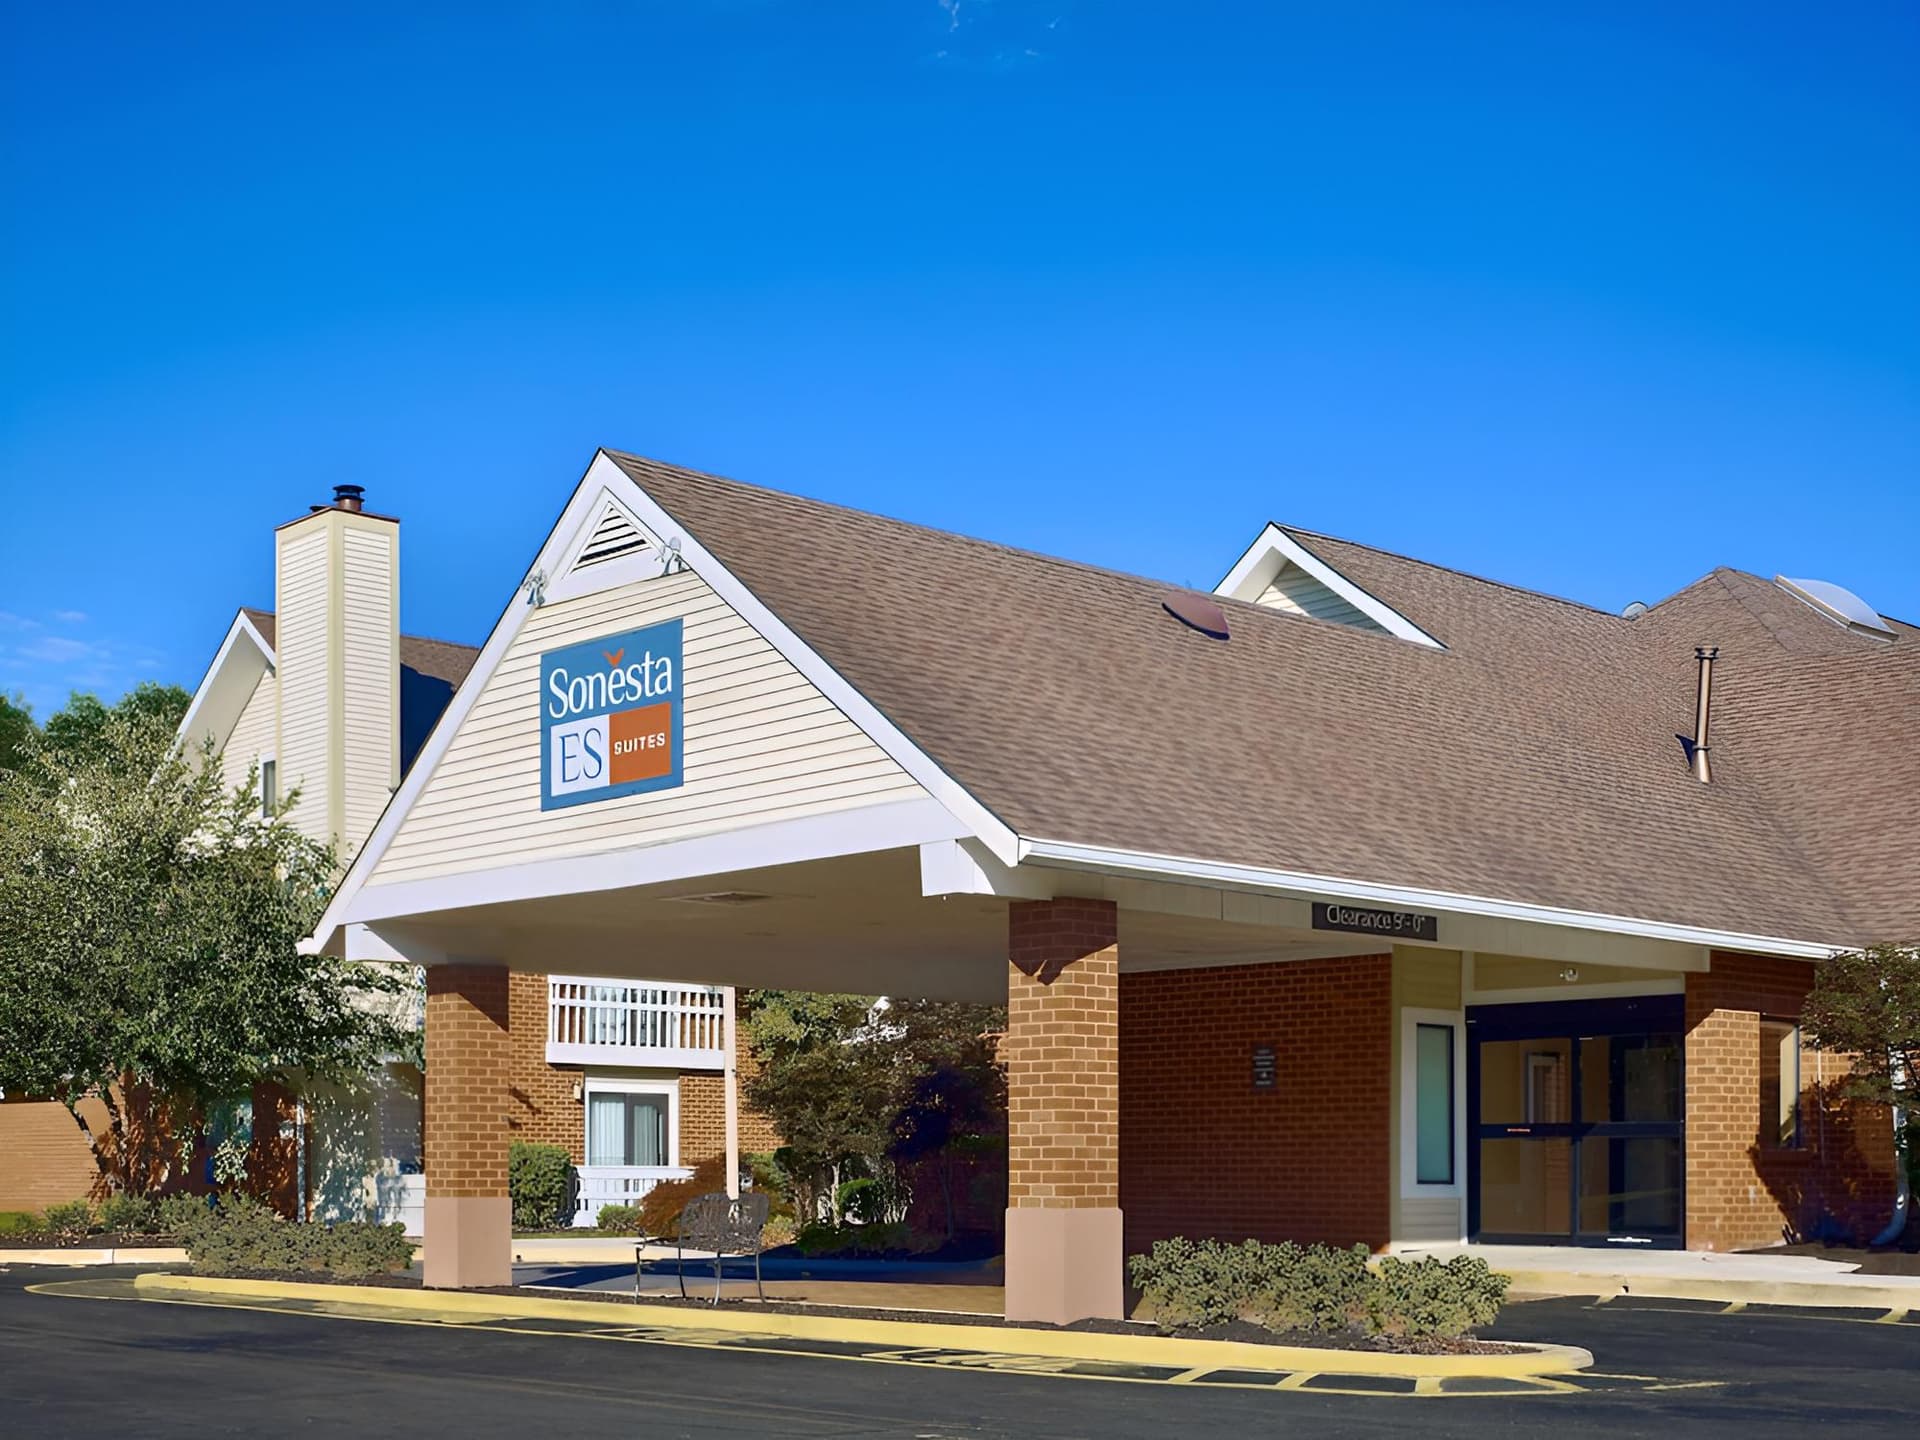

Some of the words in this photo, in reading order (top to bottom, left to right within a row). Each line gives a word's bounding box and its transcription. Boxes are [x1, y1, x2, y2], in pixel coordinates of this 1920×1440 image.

[549, 651, 672, 719] Sonesta
[559, 727, 602, 783] ES
[614, 732, 665, 755] SUITES
